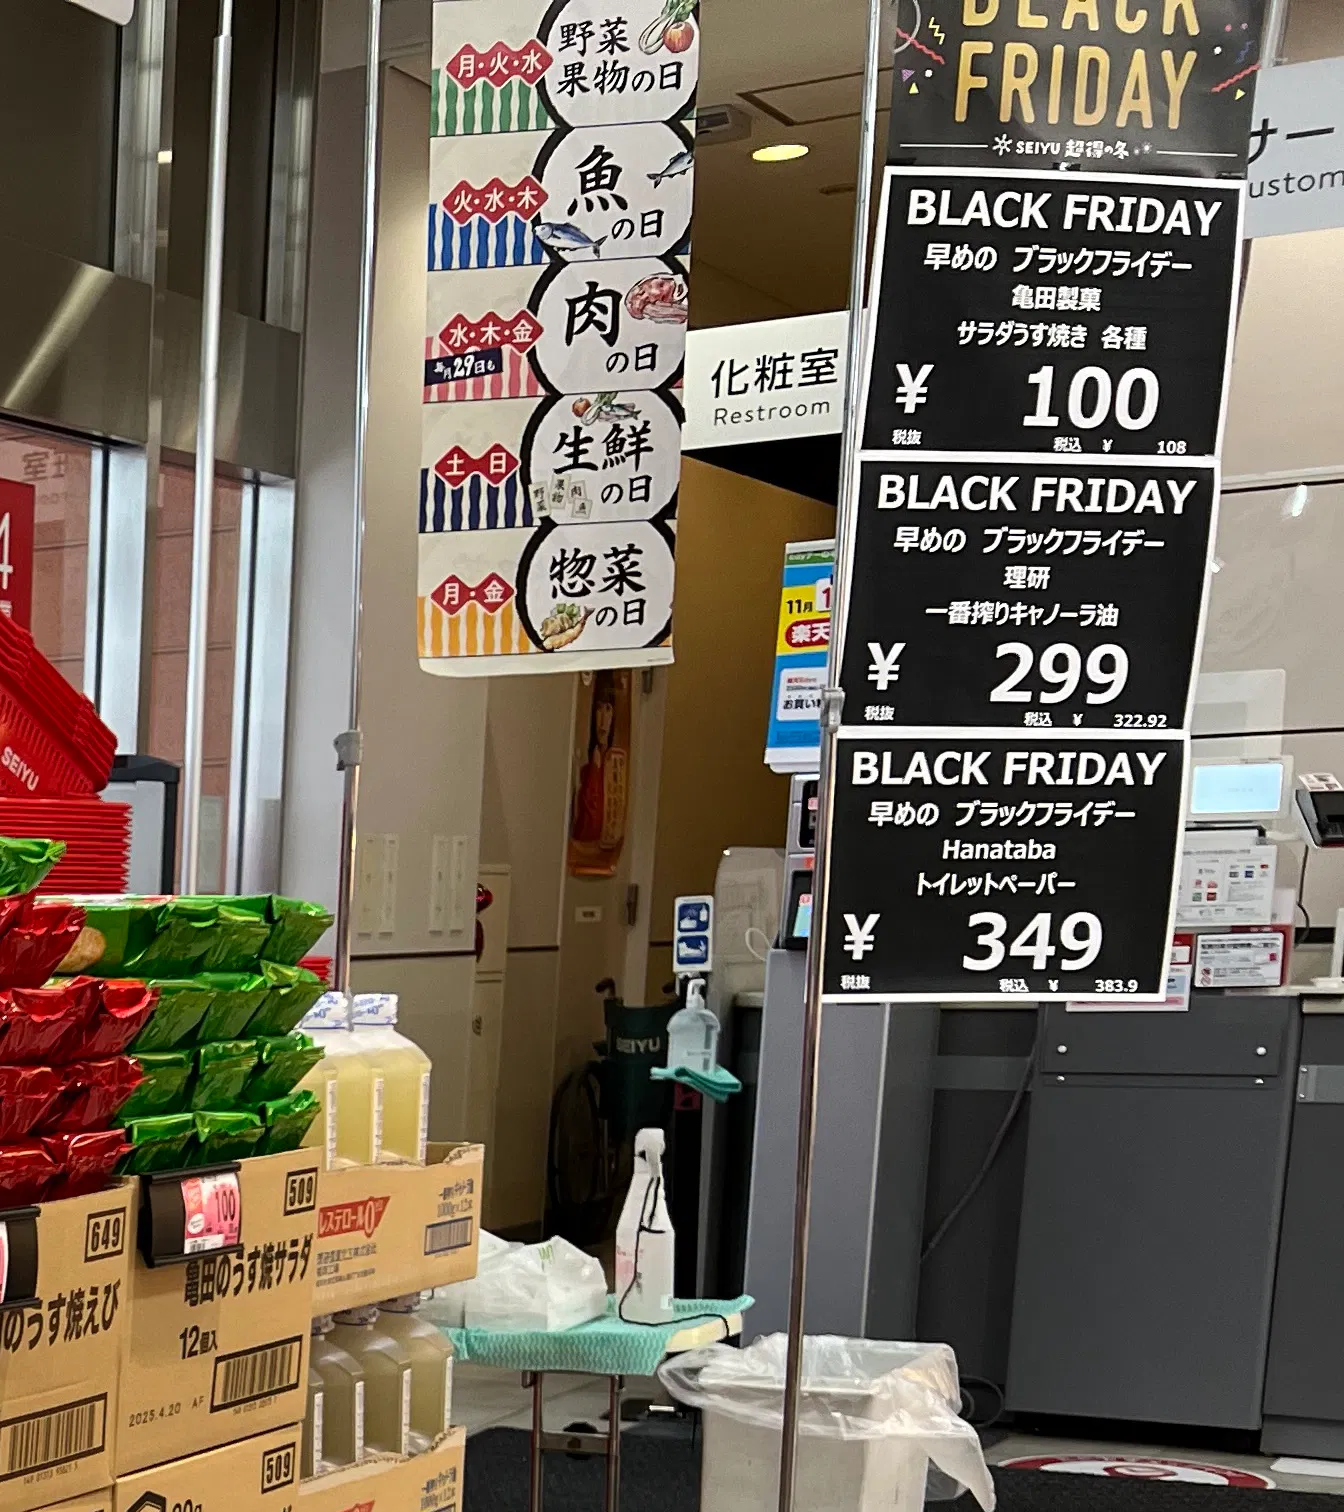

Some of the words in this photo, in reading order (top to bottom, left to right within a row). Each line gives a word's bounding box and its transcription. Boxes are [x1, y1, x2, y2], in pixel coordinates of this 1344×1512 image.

[558, 18, 631, 56] 野菜
[458, 46, 543, 77] 月・火・水
[556, 62, 685, 97] 果物の日
[955, 40, 1198, 129] FRIDAY
[1016, 141, 1061, 156] SEIYU
[567, 145, 628, 216] 魚
[453, 183, 539, 212] 火・水・木
[611, 209, 665, 240] の日
[907, 189, 1048, 229] BLACK
[1062, 195, 1222, 237] FRIDAY
[924, 243, 998, 271] 早めの
[1013, 245, 1193, 279] ブラックフライデー
[1011, 284, 1102, 313] 亀田製菓
[565, 281, 624, 348] 肉
[448, 316, 536, 347] 水・木・金
[957, 321, 1088, 348] サラダうす焼き
[1101, 324, 1148, 351] 各種
[433, 354, 496, 379] 毎月29日も
[606, 343, 659, 373] の日
[711, 348, 839, 399] 化粧室
[894, 363, 935, 415] ¥
[1023, 365, 1160, 431] 100
[713, 398, 831, 427] Restroom
[552, 420, 654, 474] 生鮮
[892, 429, 922, 446] 税抜
[1053, 436, 1082, 453] 税込
[1157, 440, 1187, 455] 108
[600, 474, 653, 505] の日
[877, 475, 1019, 511] BLACK
[1031, 477, 1197, 515] FRIDAY
[894, 527, 966, 554] 早めの
[982, 527, 1165, 557] ブラックフライデー
[549, 543, 647, 599] 惣菜
[1004, 565, 1051, 589] 理研
[442, 582, 505, 606] 月・金
[786, 597, 813, 614] 11月
[595, 598, 647, 626] の日
[924, 601, 1119, 628] 一番搾りキャノーラ油
[866, 641, 906, 691] ¥
[989, 642, 1130, 705] 299
[864, 705, 895, 721] 税抜
[1024, 711, 1053, 727] 税込
[1113, 713, 1168, 729] 322.92
[0, 746, 40, 792] SEIYU
[852, 751, 991, 786] BLACK
[1002, 751, 1168, 787] FRIDAY
[868, 801, 940, 827] 早めの
[955, 801, 1136, 828] ブラックフライデー
[942, 839, 1056, 861] Hanataba
[916, 871, 1077, 897] トイレットペーパー
[842, 912, 881, 961] ¥
[962, 912, 1104, 971] 349
[840, 974, 870, 990] 税抜
[999, 977, 1029, 993] 税込
[1094, 978, 1138, 993] 383.9
[289, 1177, 313, 1205] 509
[216, 1190, 236, 1223] 100
[91, 1219, 118, 1249] 649
[185, 1237, 313, 1306] 亀田のうす焼サラダ
[180, 1326, 217, 1360] 12個入
[129, 1402, 181, 1427] 2025.4.20
[266, 1454, 292, 1484] 509
